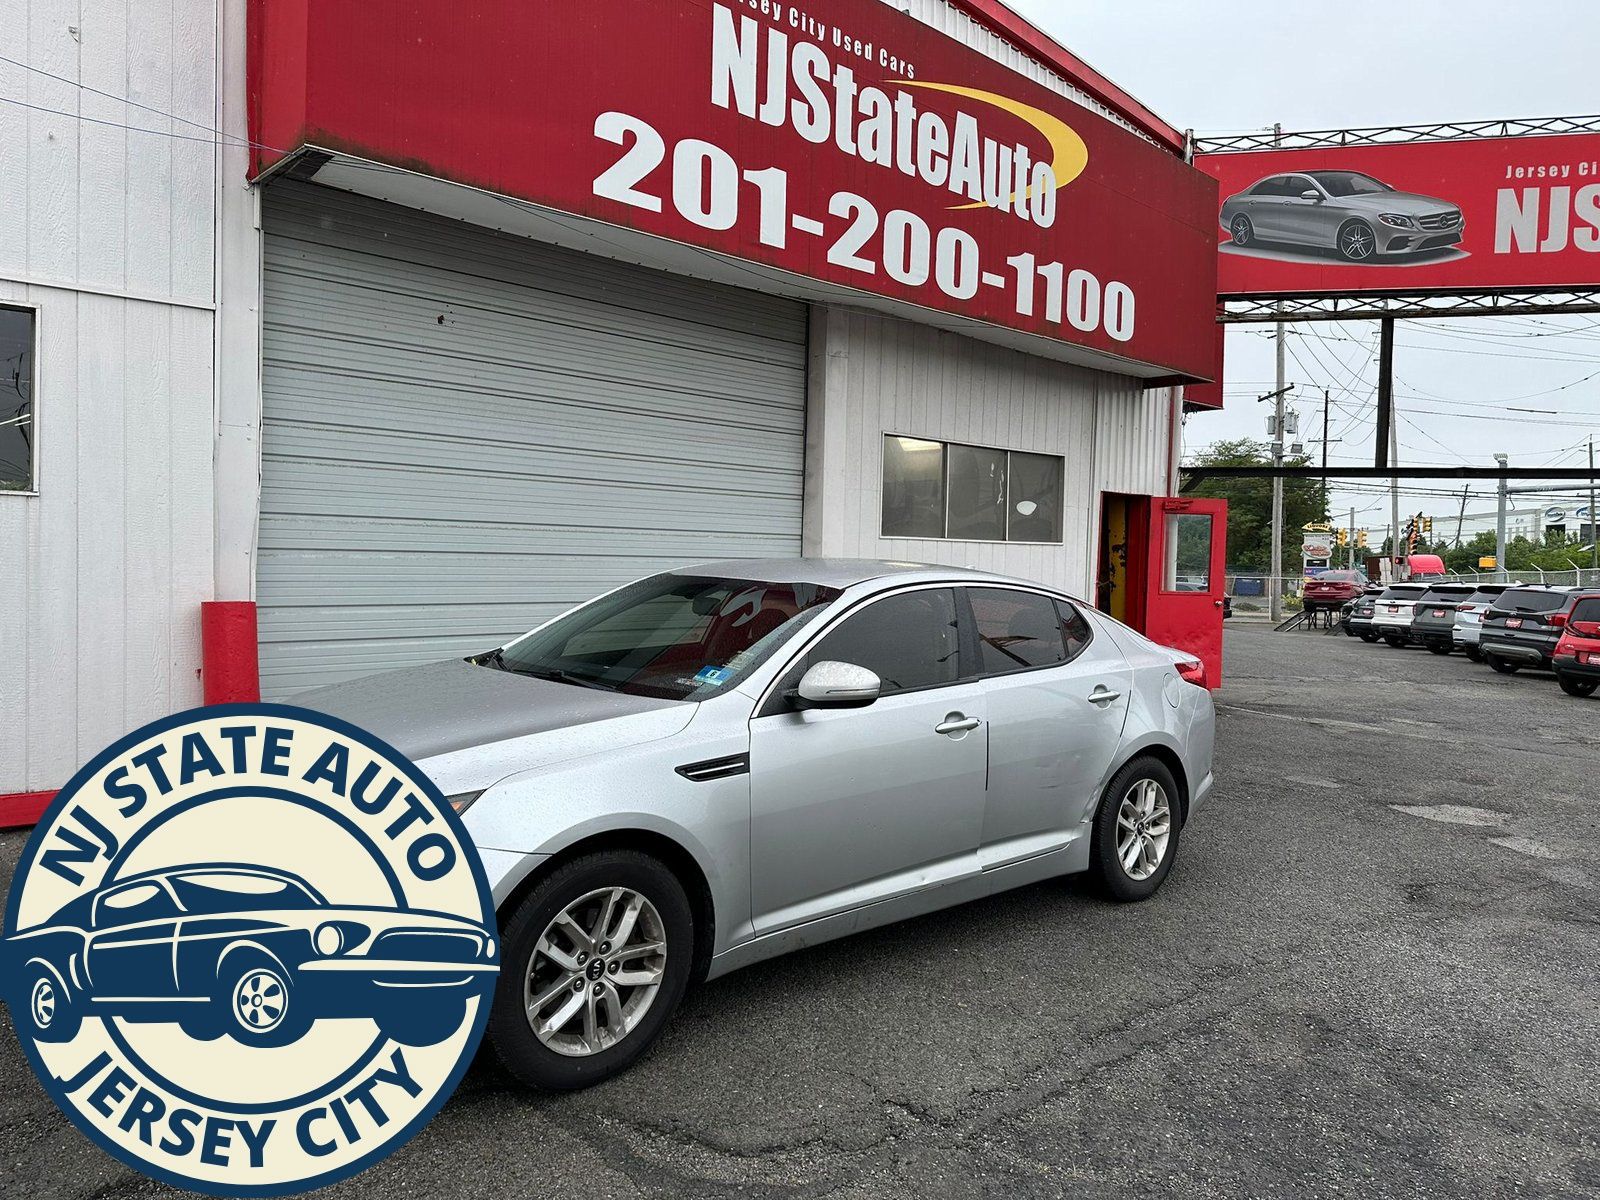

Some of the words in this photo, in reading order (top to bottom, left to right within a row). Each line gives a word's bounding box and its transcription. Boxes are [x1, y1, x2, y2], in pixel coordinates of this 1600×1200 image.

[739, 0, 781, 21] sey
[789, 7, 826, 42] City
[832, 26, 873, 61] Used
[879, 48, 915, 80] Cars
[711, 1, 1057, 229] NJStateAuto
[1505, 164, 1570, 179] Jersey
[1578, 161, 1598, 176] Ci
[592, 111, 1136, 342] 201-200-1100
[592, 960, 601, 979] KIA
